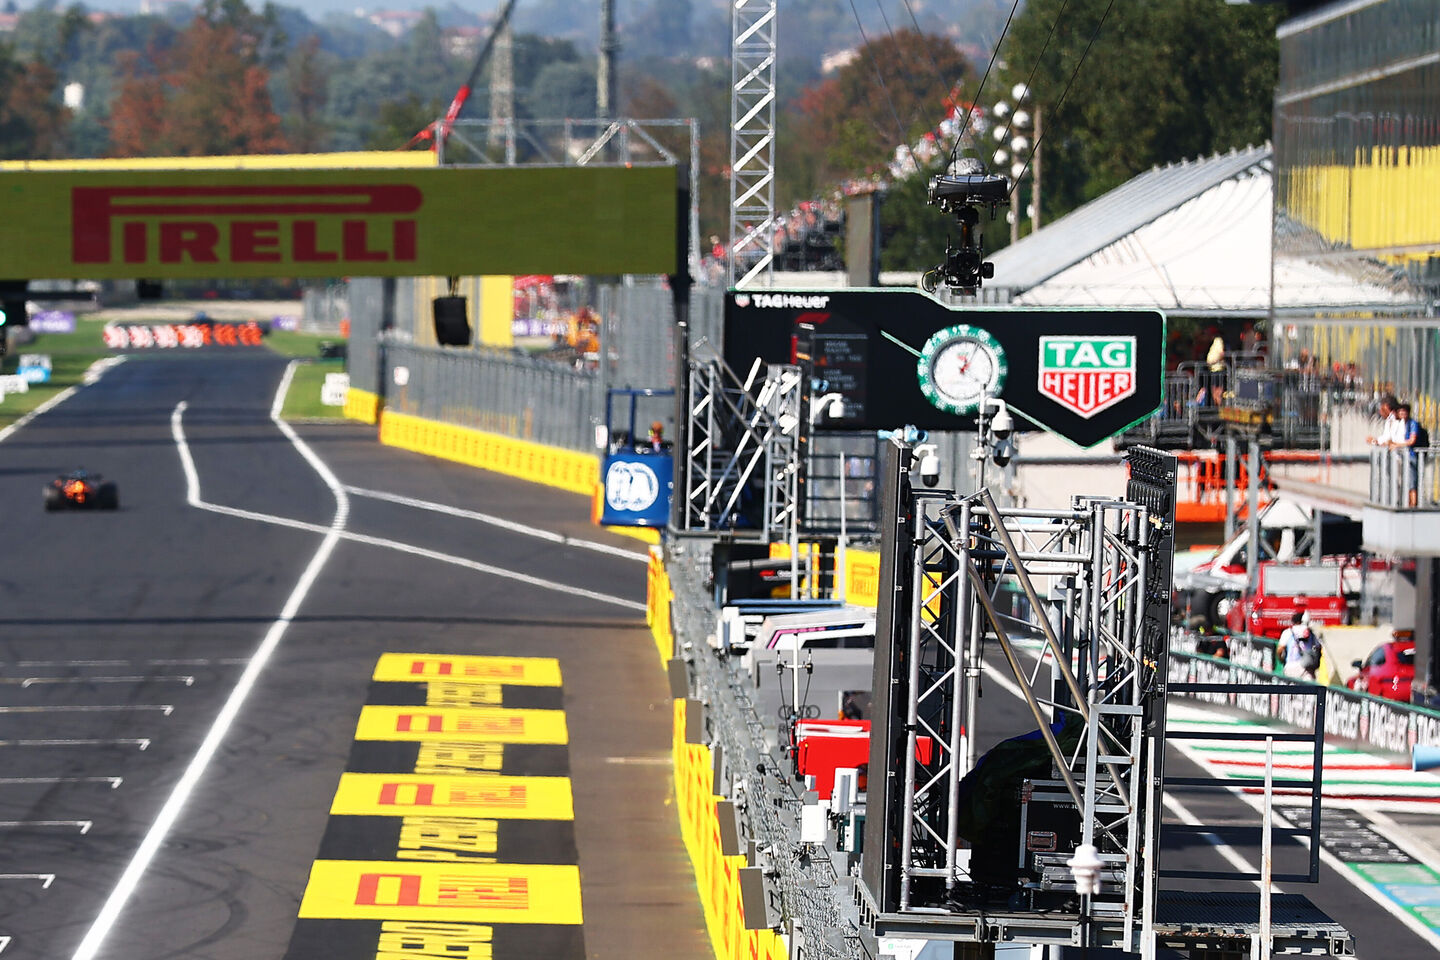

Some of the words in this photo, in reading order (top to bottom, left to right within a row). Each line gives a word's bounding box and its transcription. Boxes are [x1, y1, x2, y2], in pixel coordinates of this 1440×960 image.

[72, 185, 423, 263] PIRELLI
[1047, 342, 1128, 367] TAG
[1045, 372, 1131, 412] HEUER
[354, 873, 530, 910] PIRELLI
